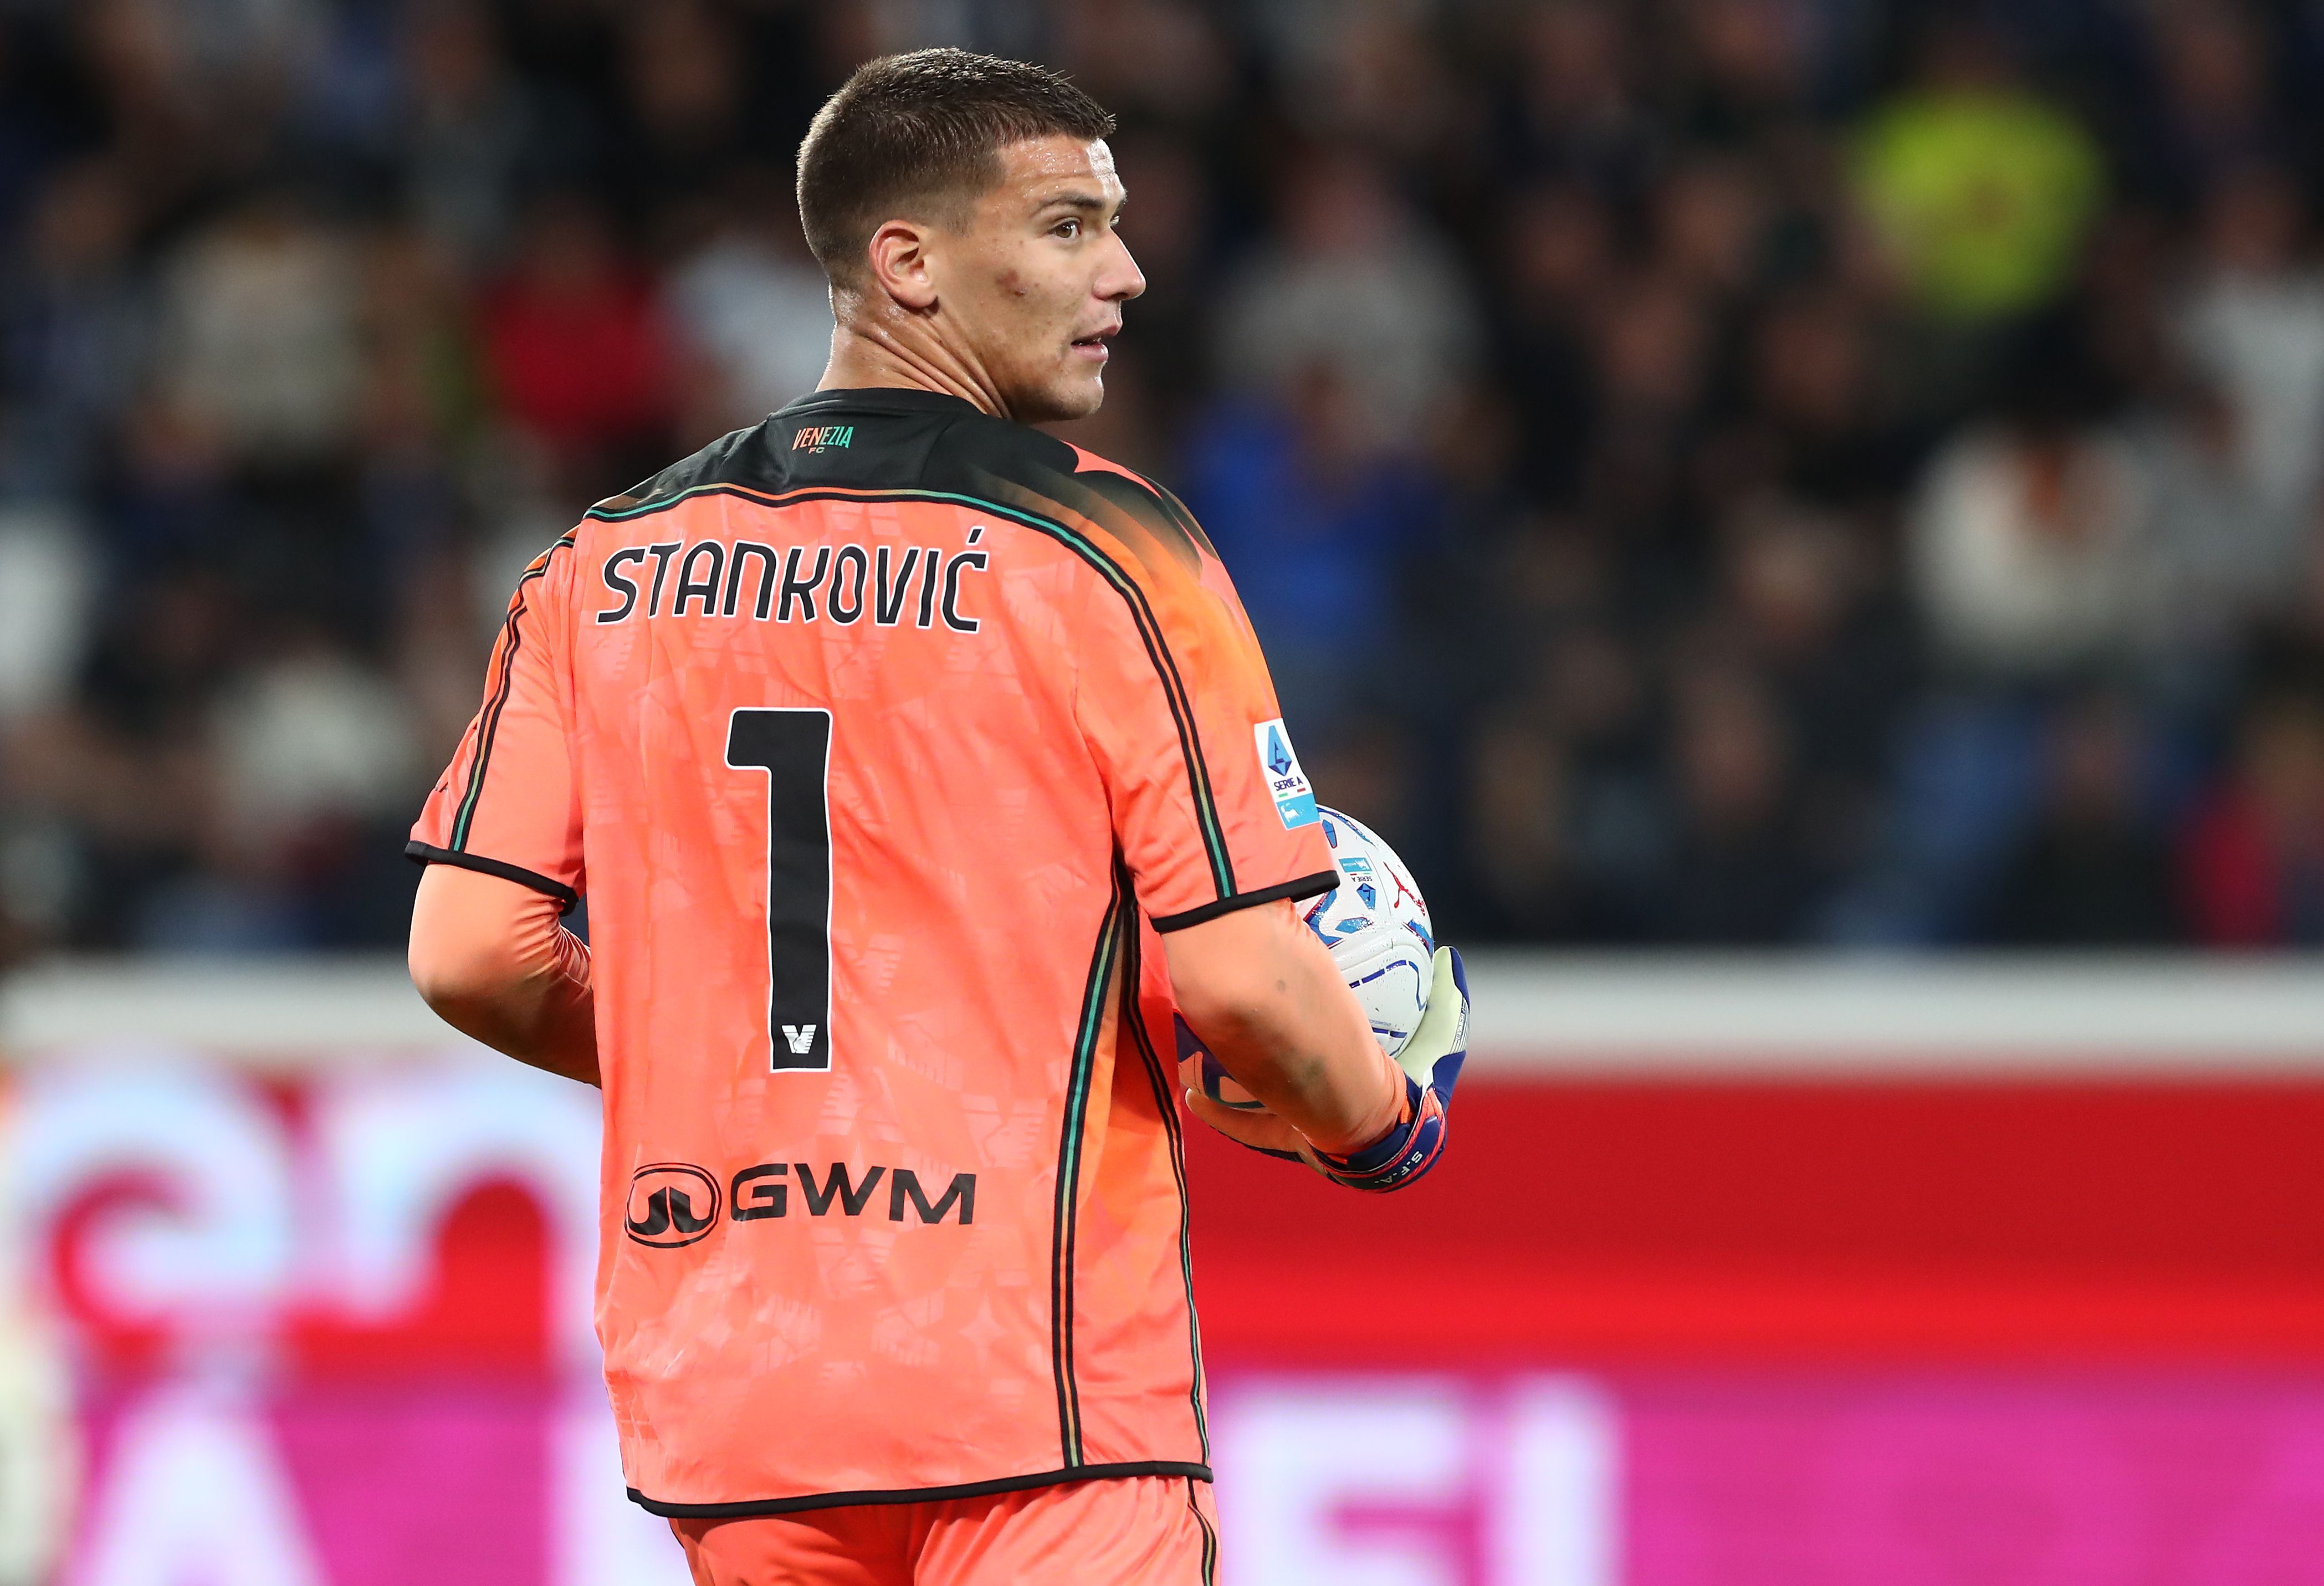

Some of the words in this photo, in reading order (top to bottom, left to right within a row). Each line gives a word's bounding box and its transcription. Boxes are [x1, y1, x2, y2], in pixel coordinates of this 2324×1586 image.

[791, 425, 854, 451] VENEZIA
[808, 446, 825, 454] FC
[596, 525, 989, 634] STANKOVIĆ
[1273, 777, 1297, 791] SERIE
[1296, 776, 1304, 785] A
[724, 707, 833, 1073] 1
[1374, 1150, 1423, 1184] S.F.A.
[730, 1162, 977, 1225] GWM
